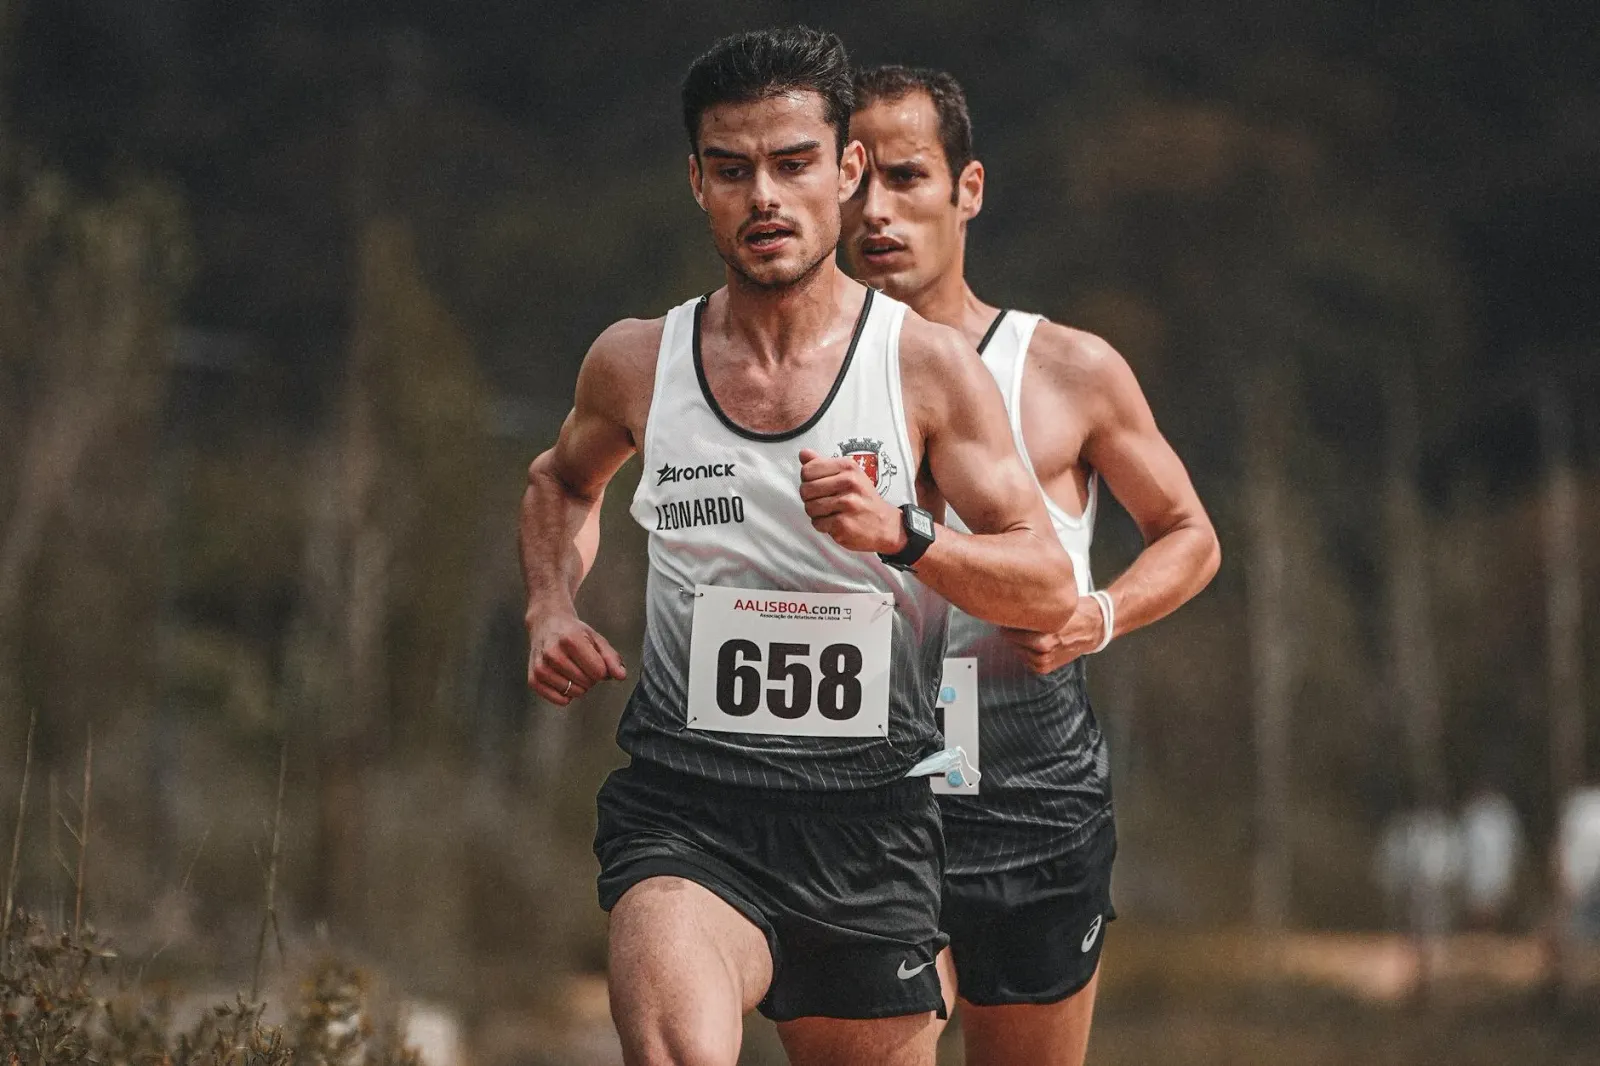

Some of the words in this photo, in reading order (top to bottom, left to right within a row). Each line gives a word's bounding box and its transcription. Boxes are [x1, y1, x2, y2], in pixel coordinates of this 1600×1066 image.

[655, 496, 745, 531] LEONARDO
[734, 599, 841, 615] AALISBOA.com
[716, 638, 862, 721] 658
